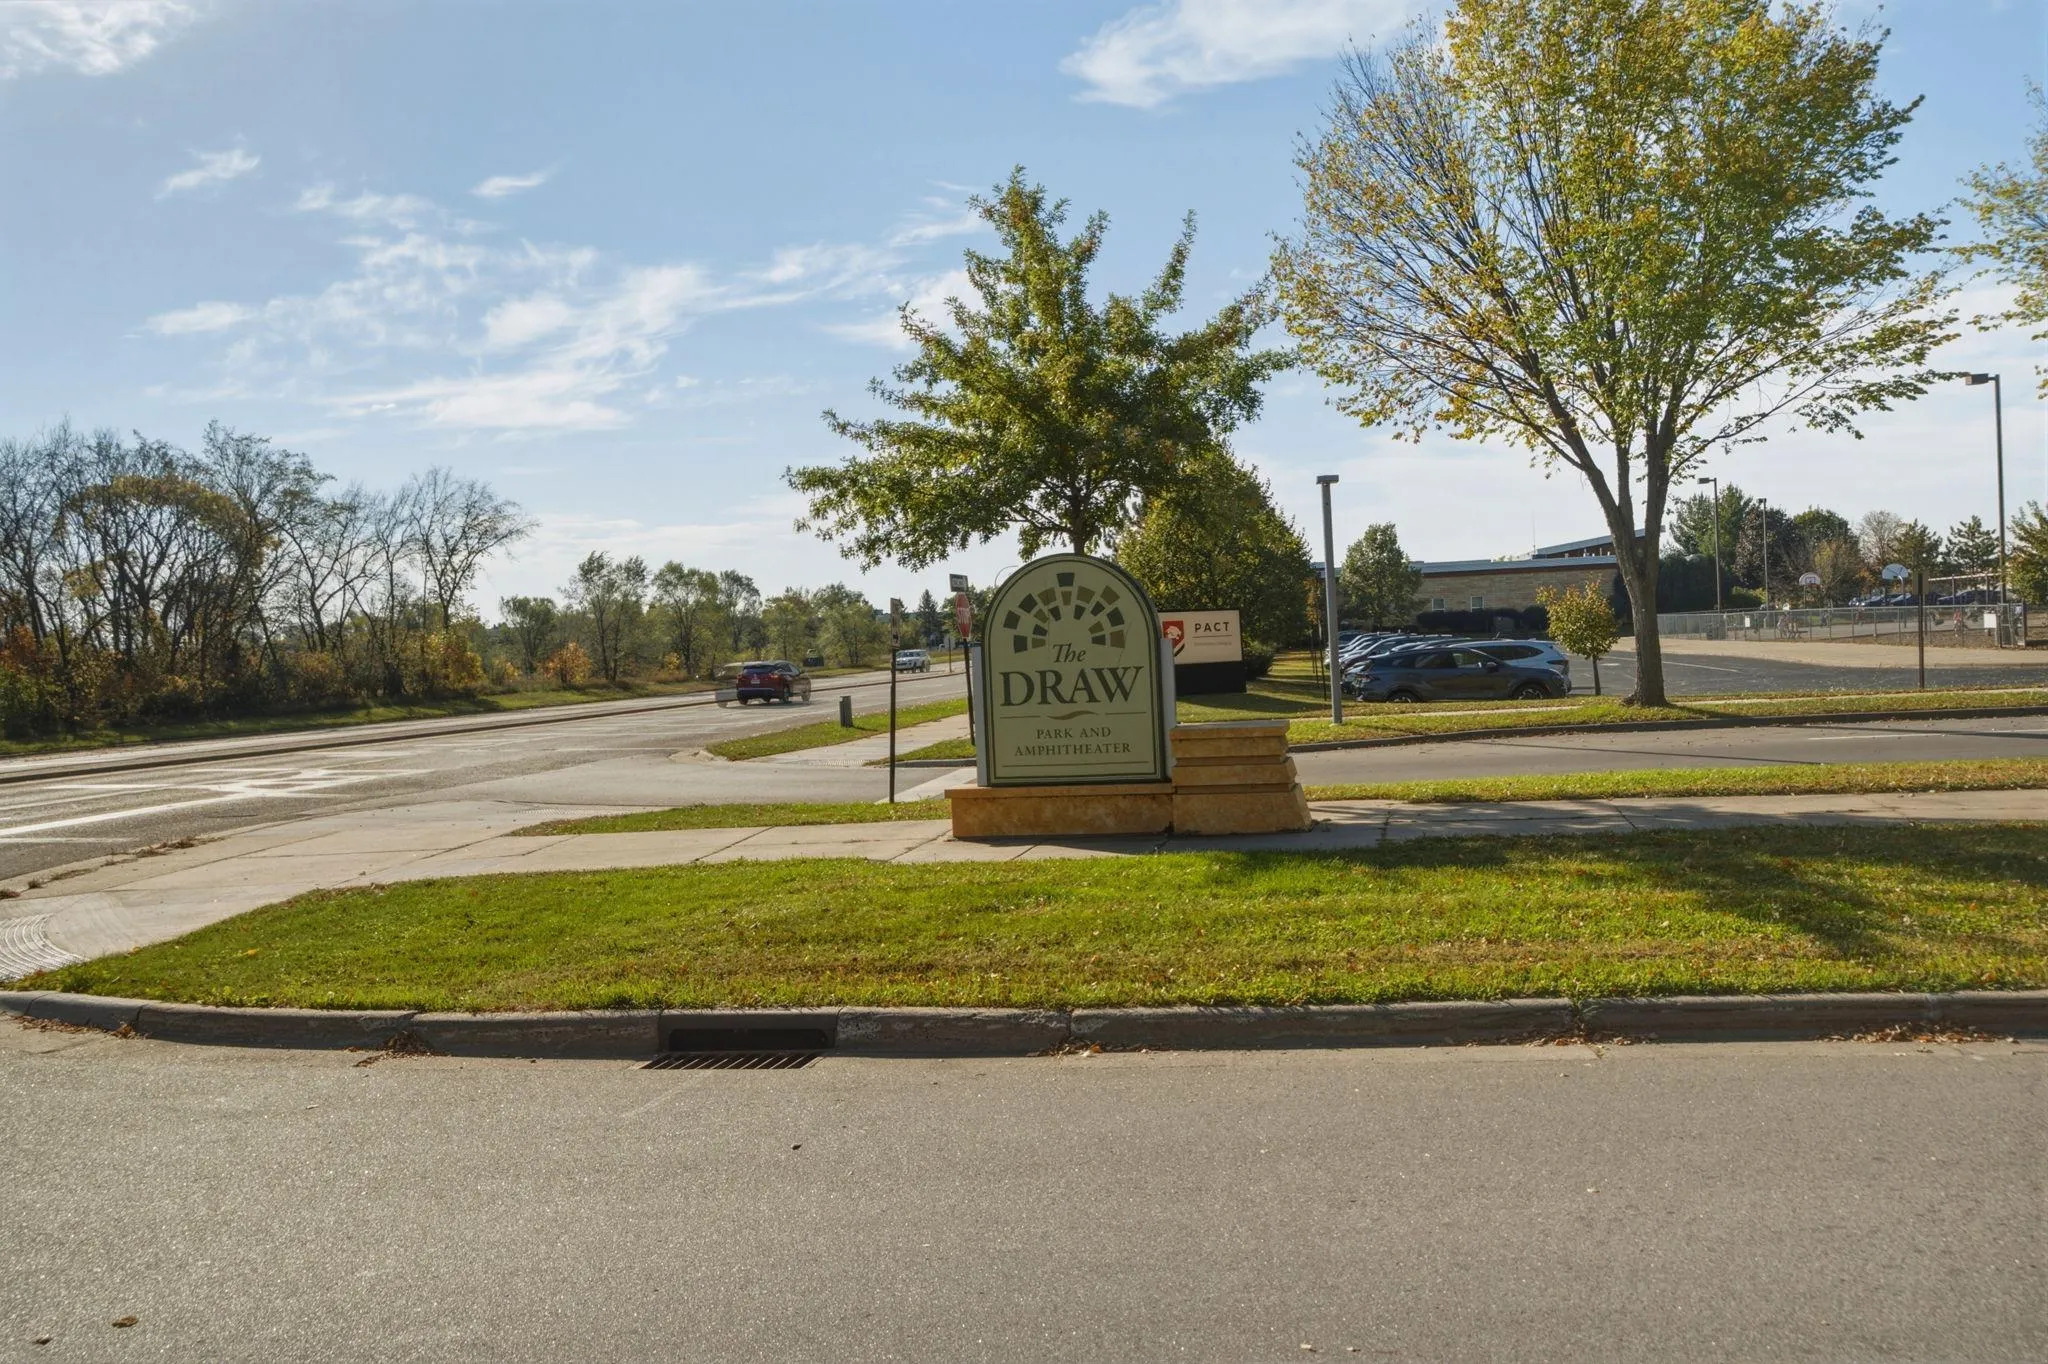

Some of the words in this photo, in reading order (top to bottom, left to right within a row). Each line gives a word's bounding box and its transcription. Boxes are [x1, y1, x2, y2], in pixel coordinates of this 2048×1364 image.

[1194, 621, 1230, 633] PACT
[1053, 643, 1086, 663] The
[999, 666, 1144, 706] DRAW
[1036, 728, 1073, 739] PARK
[1079, 727, 1111, 738] AND
[1014, 743, 1132, 757] AMPHITHEATER
